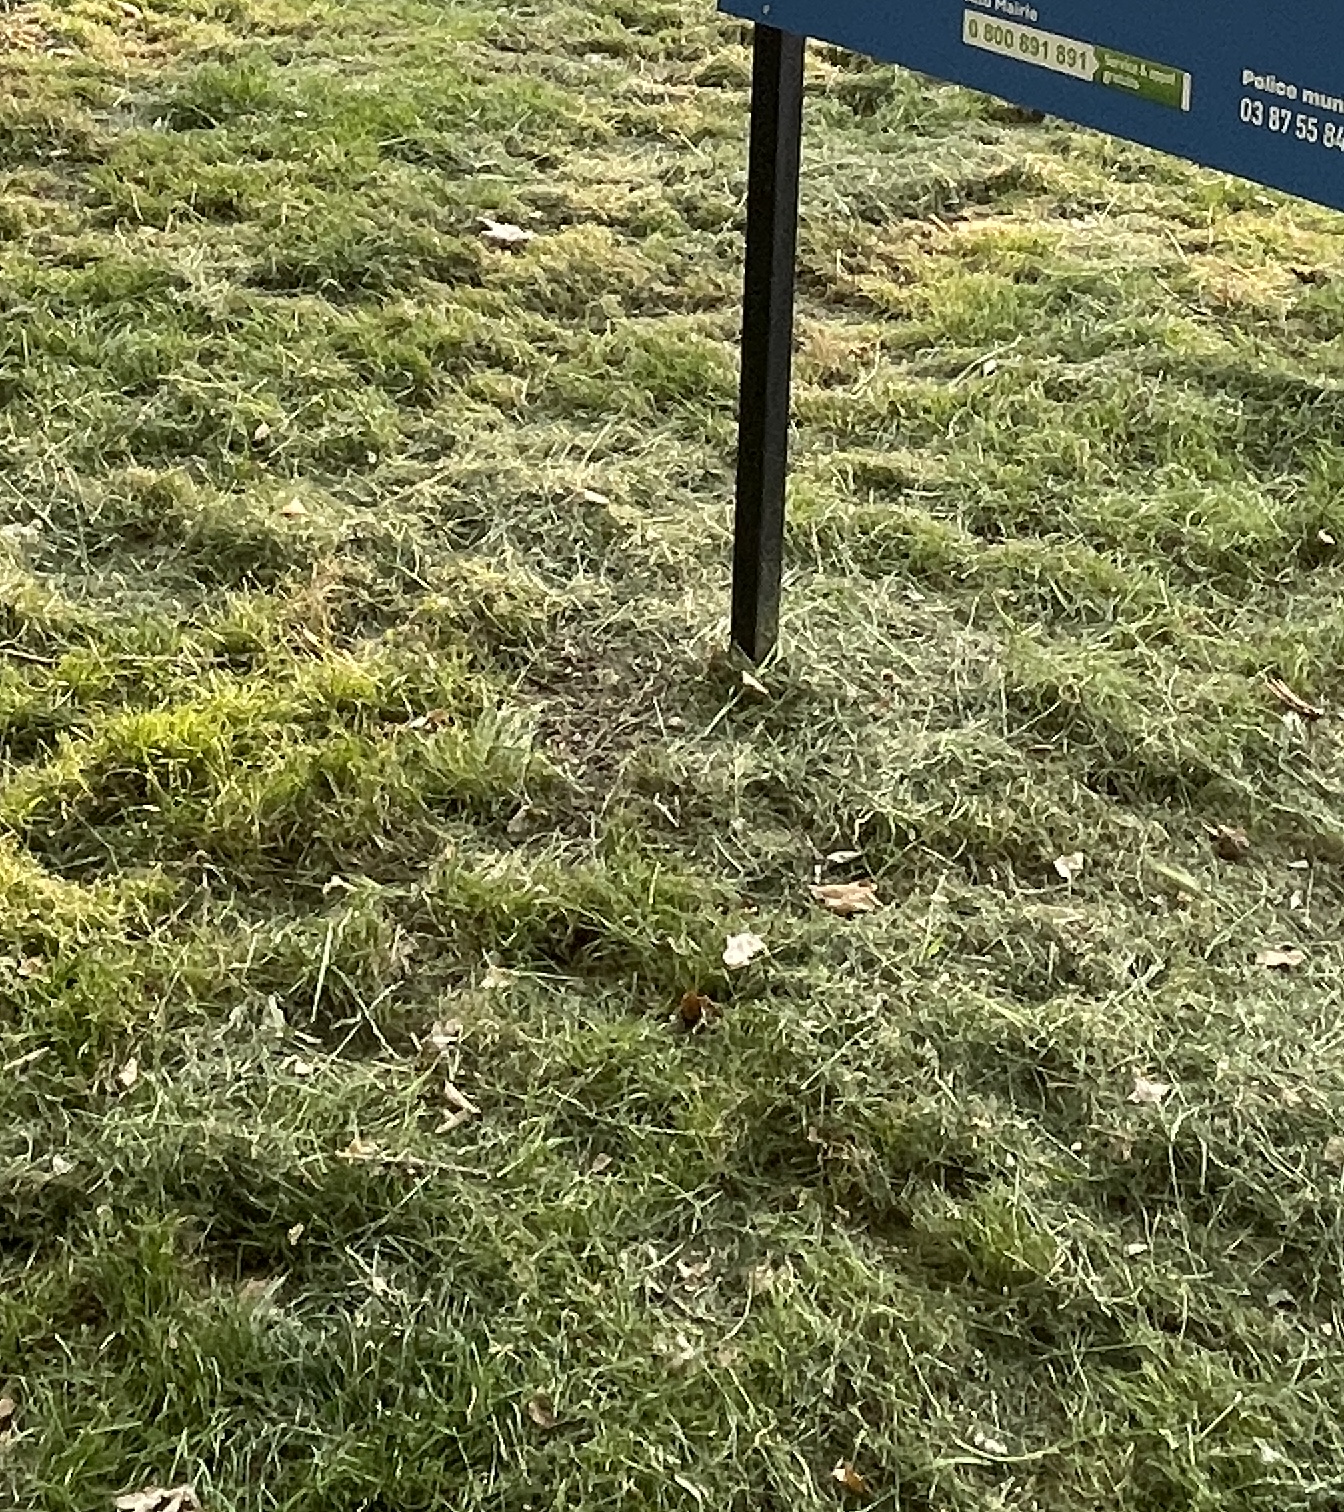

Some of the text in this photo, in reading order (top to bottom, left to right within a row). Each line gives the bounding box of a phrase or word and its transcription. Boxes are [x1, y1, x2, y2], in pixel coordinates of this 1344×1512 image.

[968, 18, 979, 39] 0
[983, 23, 1014, 49] 800
[1018, 32, 1049, 60] 891
[1056, 44, 1087, 71] 891
[1242, 69, 1298, 100] Police
[1240, 97, 1264, 126] 03
[1268, 105, 1292, 134] 87
[1295, 113, 1319, 143] 55
